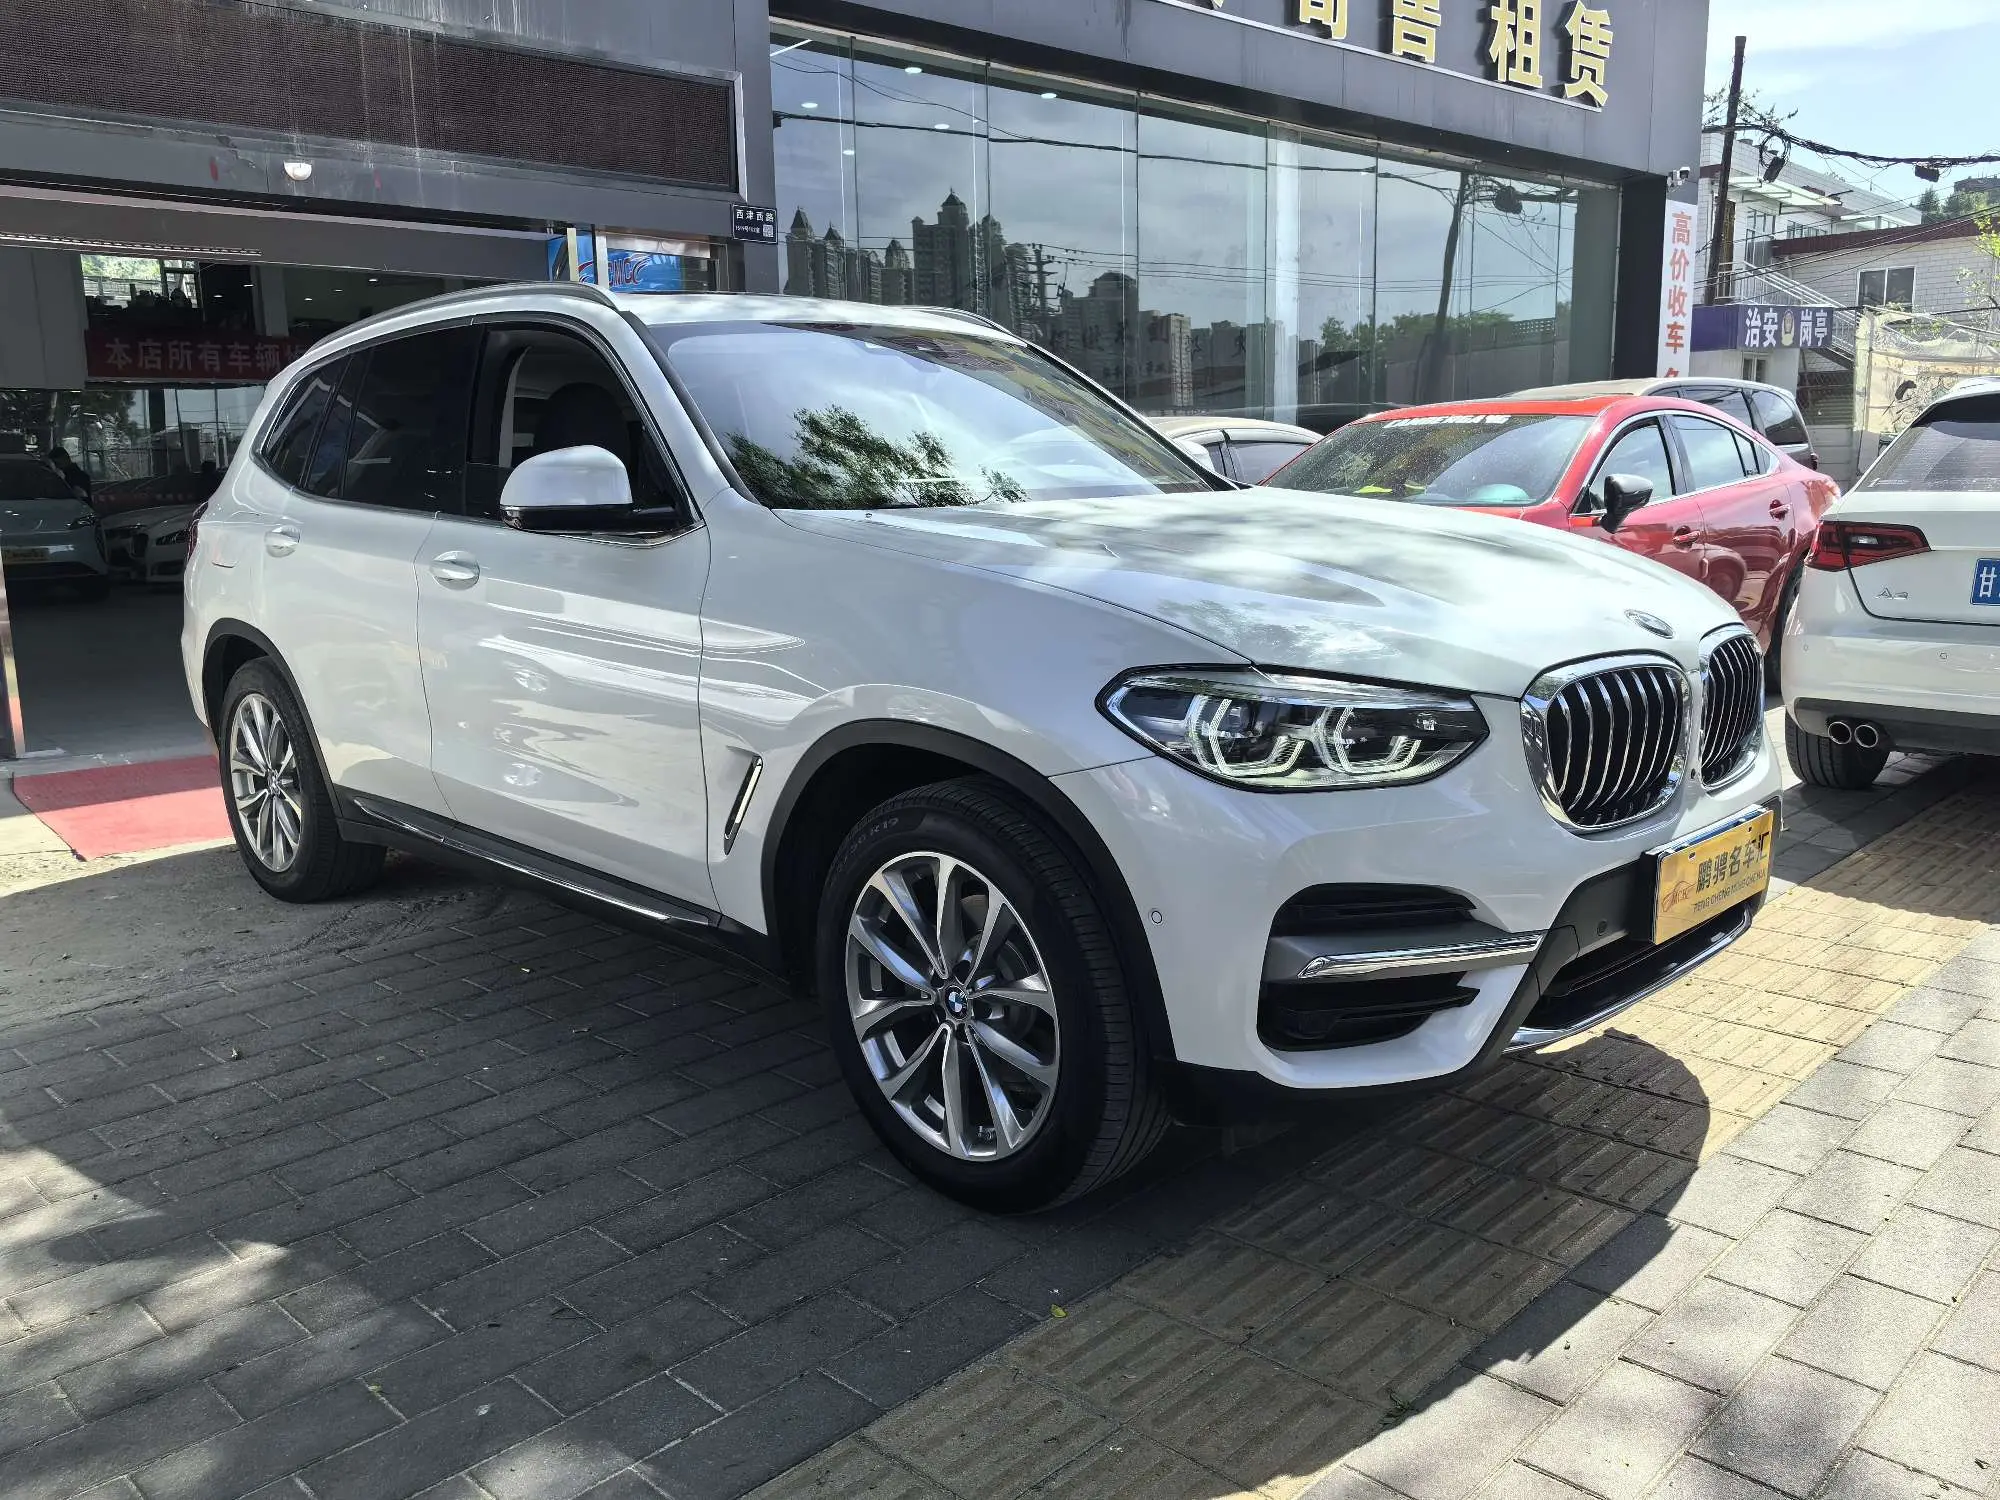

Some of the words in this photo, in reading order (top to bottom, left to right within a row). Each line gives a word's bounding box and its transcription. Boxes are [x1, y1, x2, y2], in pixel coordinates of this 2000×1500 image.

[736, 209, 774, 222] 西津西路
[1665, 211, 1692, 355] 高价收车
[1745, 307, 1828, 347] 治安岗亭
